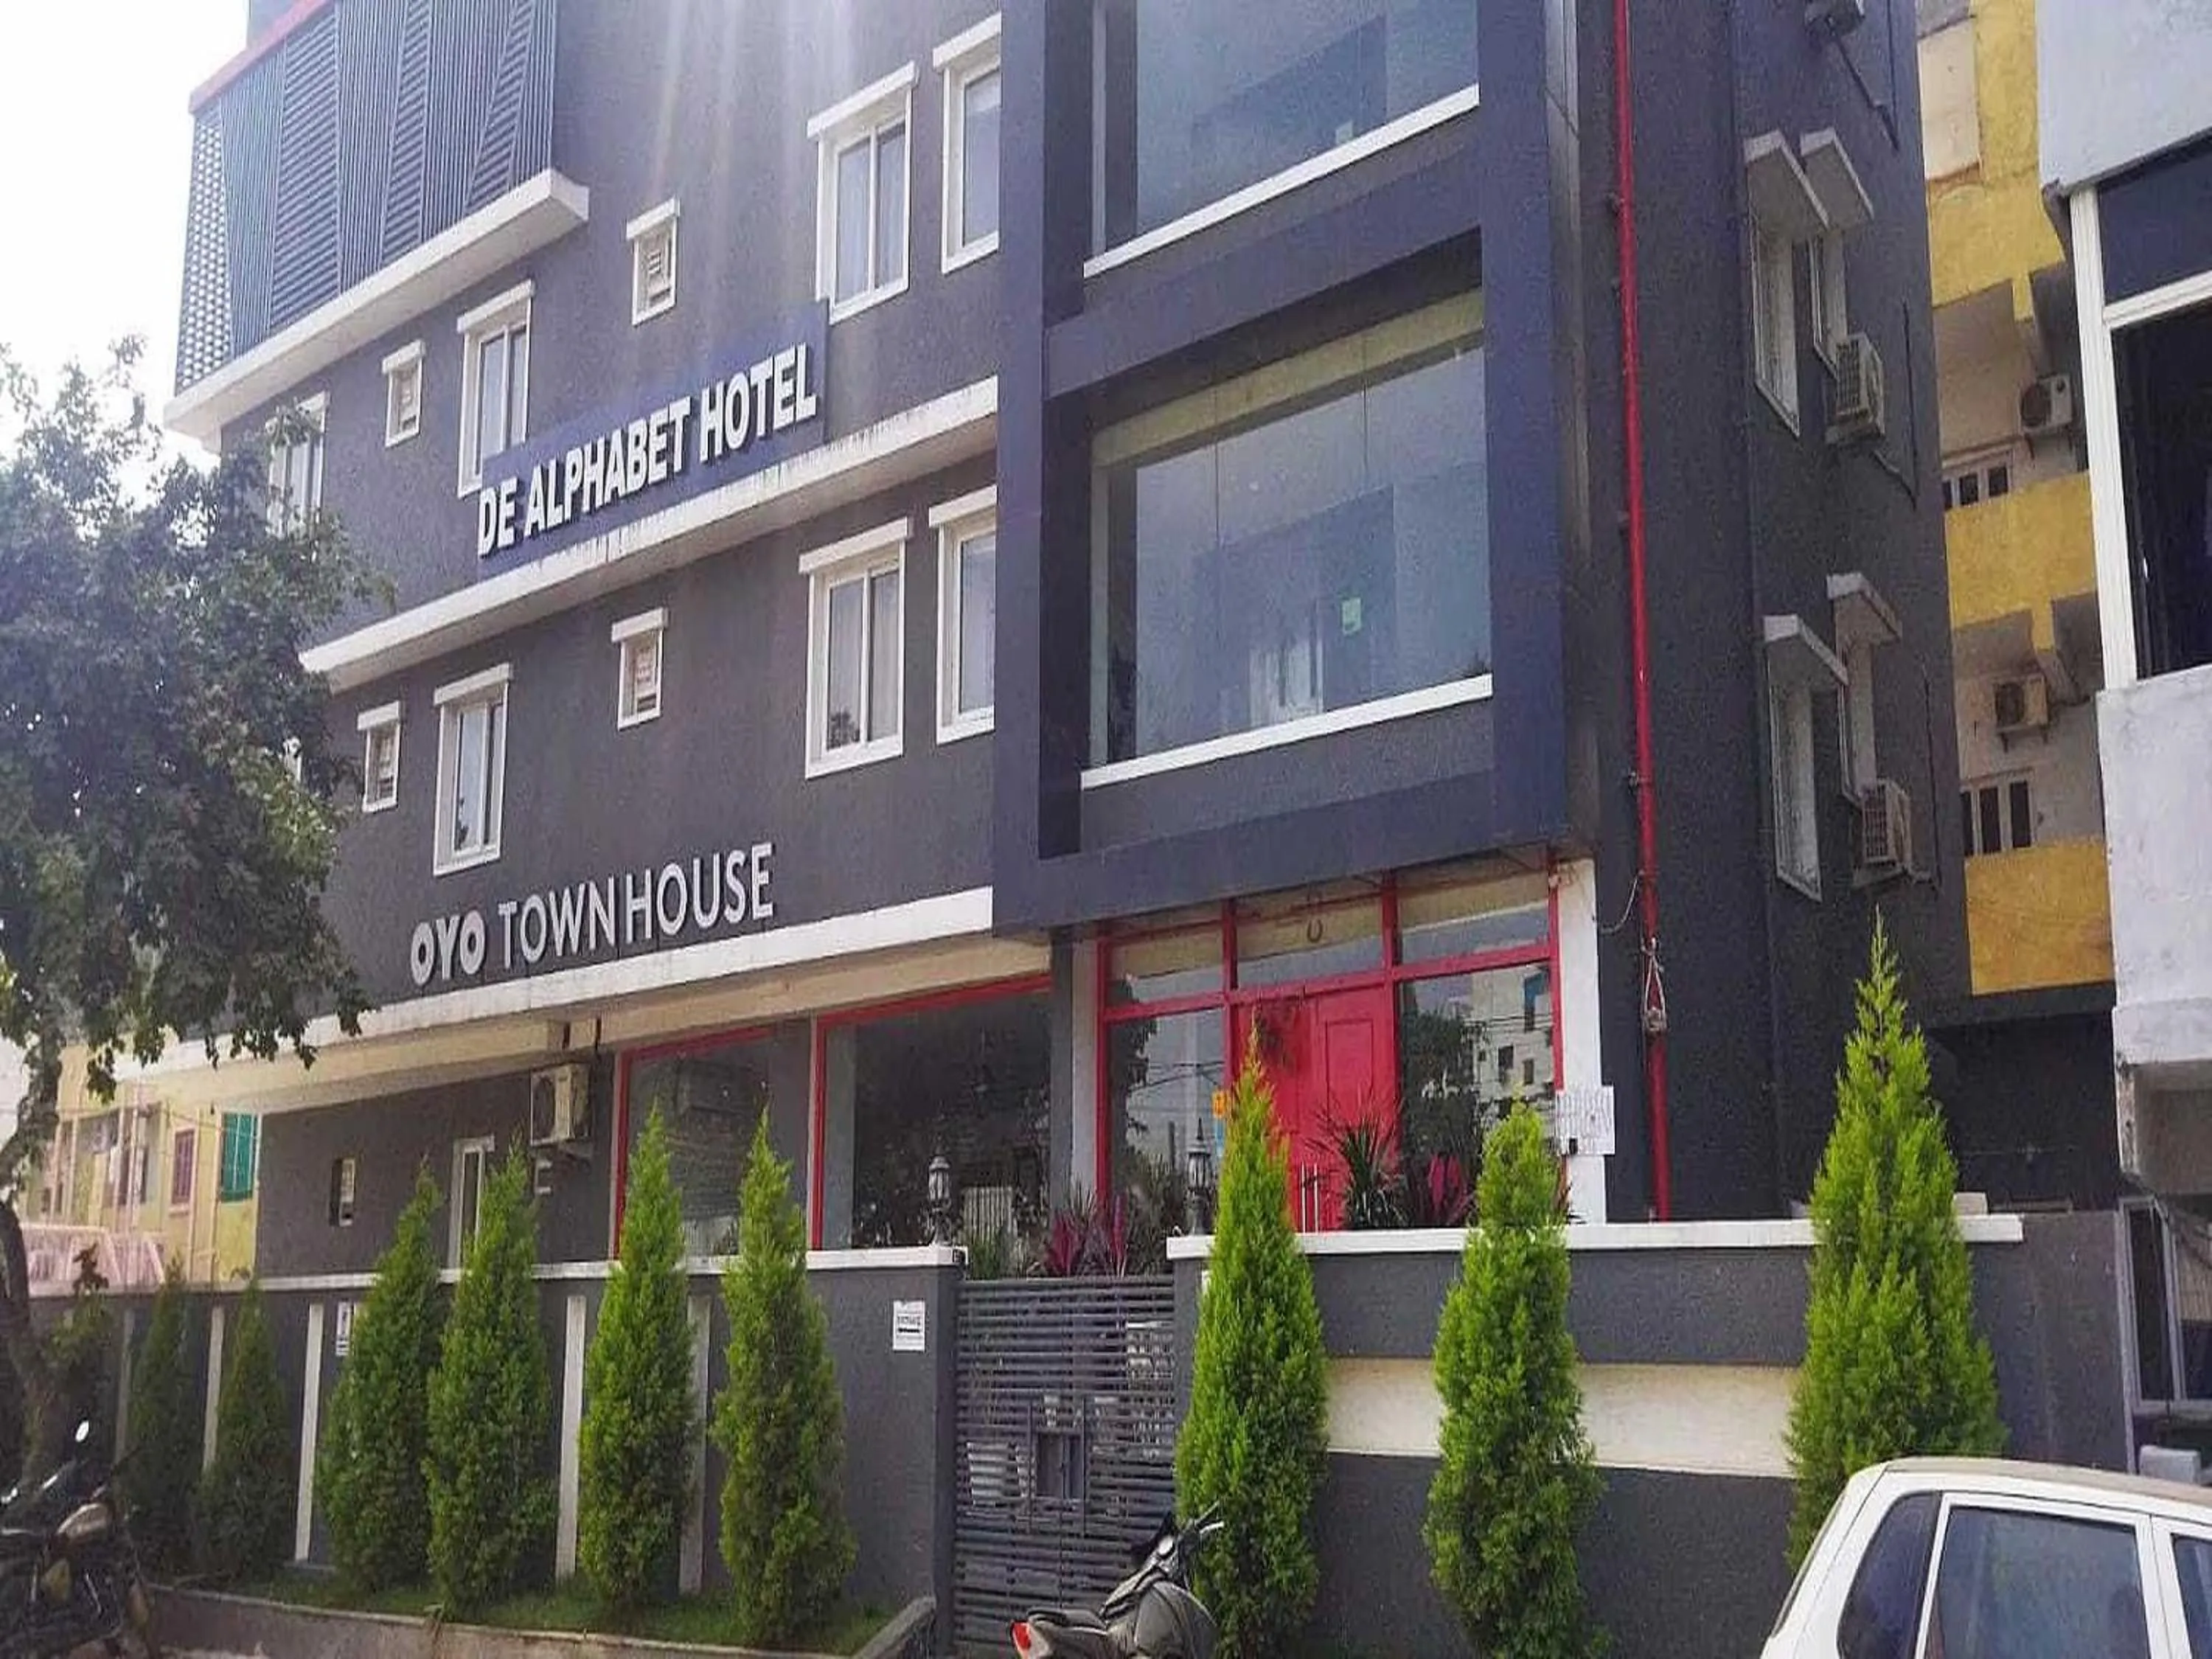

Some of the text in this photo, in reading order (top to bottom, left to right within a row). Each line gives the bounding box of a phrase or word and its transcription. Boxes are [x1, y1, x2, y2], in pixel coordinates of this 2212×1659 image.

[477, 342, 818, 558] DE ALPHABET HOTEL
[410, 909, 486, 987] OYO
